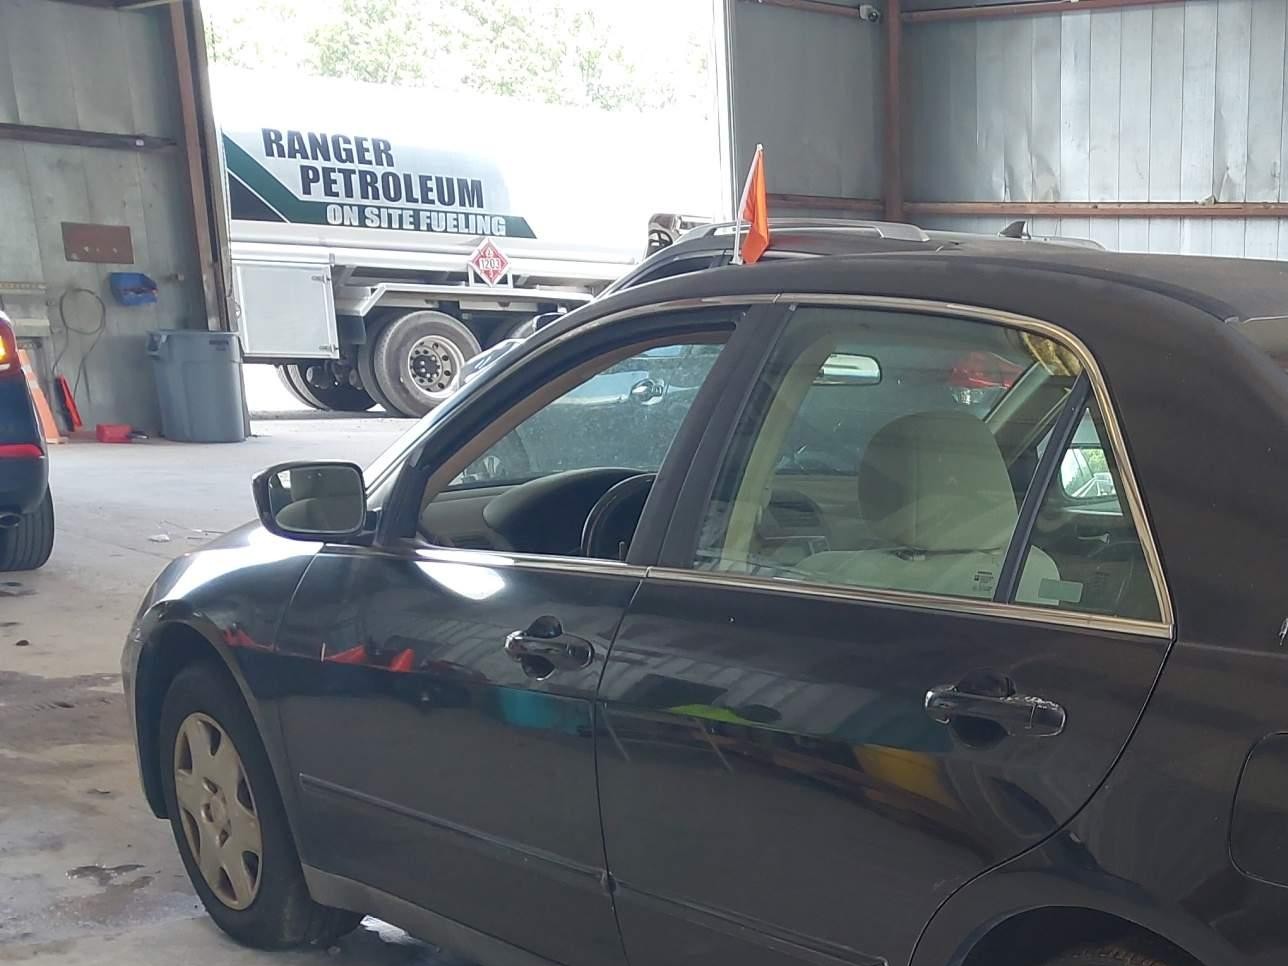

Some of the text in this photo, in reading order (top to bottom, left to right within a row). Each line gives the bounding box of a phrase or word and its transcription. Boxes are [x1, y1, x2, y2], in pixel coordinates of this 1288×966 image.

[261, 127, 395, 167] RANGER
[299, 164, 484, 209] PETROLEUM
[326, 203, 507, 236] ON SITE FUELING
[480, 258, 500, 269] 1203
